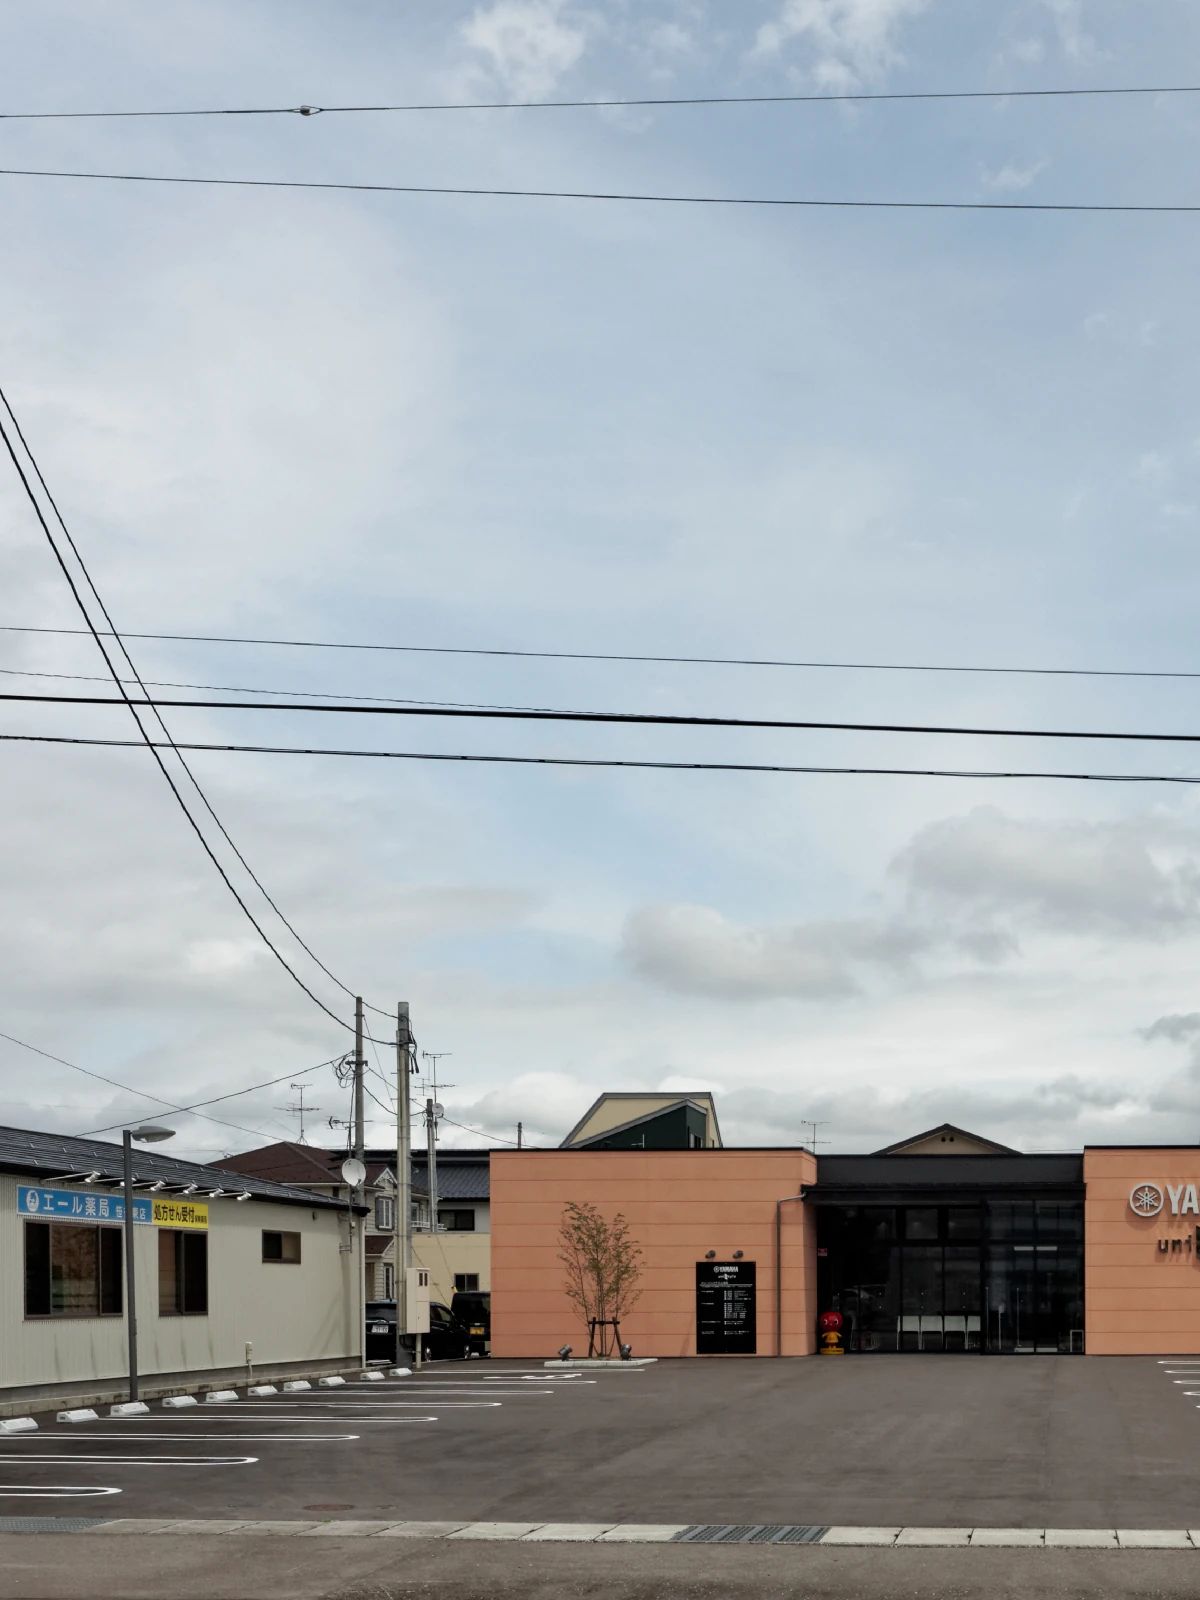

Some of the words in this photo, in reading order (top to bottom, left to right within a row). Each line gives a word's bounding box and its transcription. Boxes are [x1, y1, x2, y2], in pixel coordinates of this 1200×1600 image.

[43, 1193, 110, 1218] エール薬局
[115, 1205, 147, 1220] 笹東店
[154, 1203, 196, 1224] 処方せん受付
